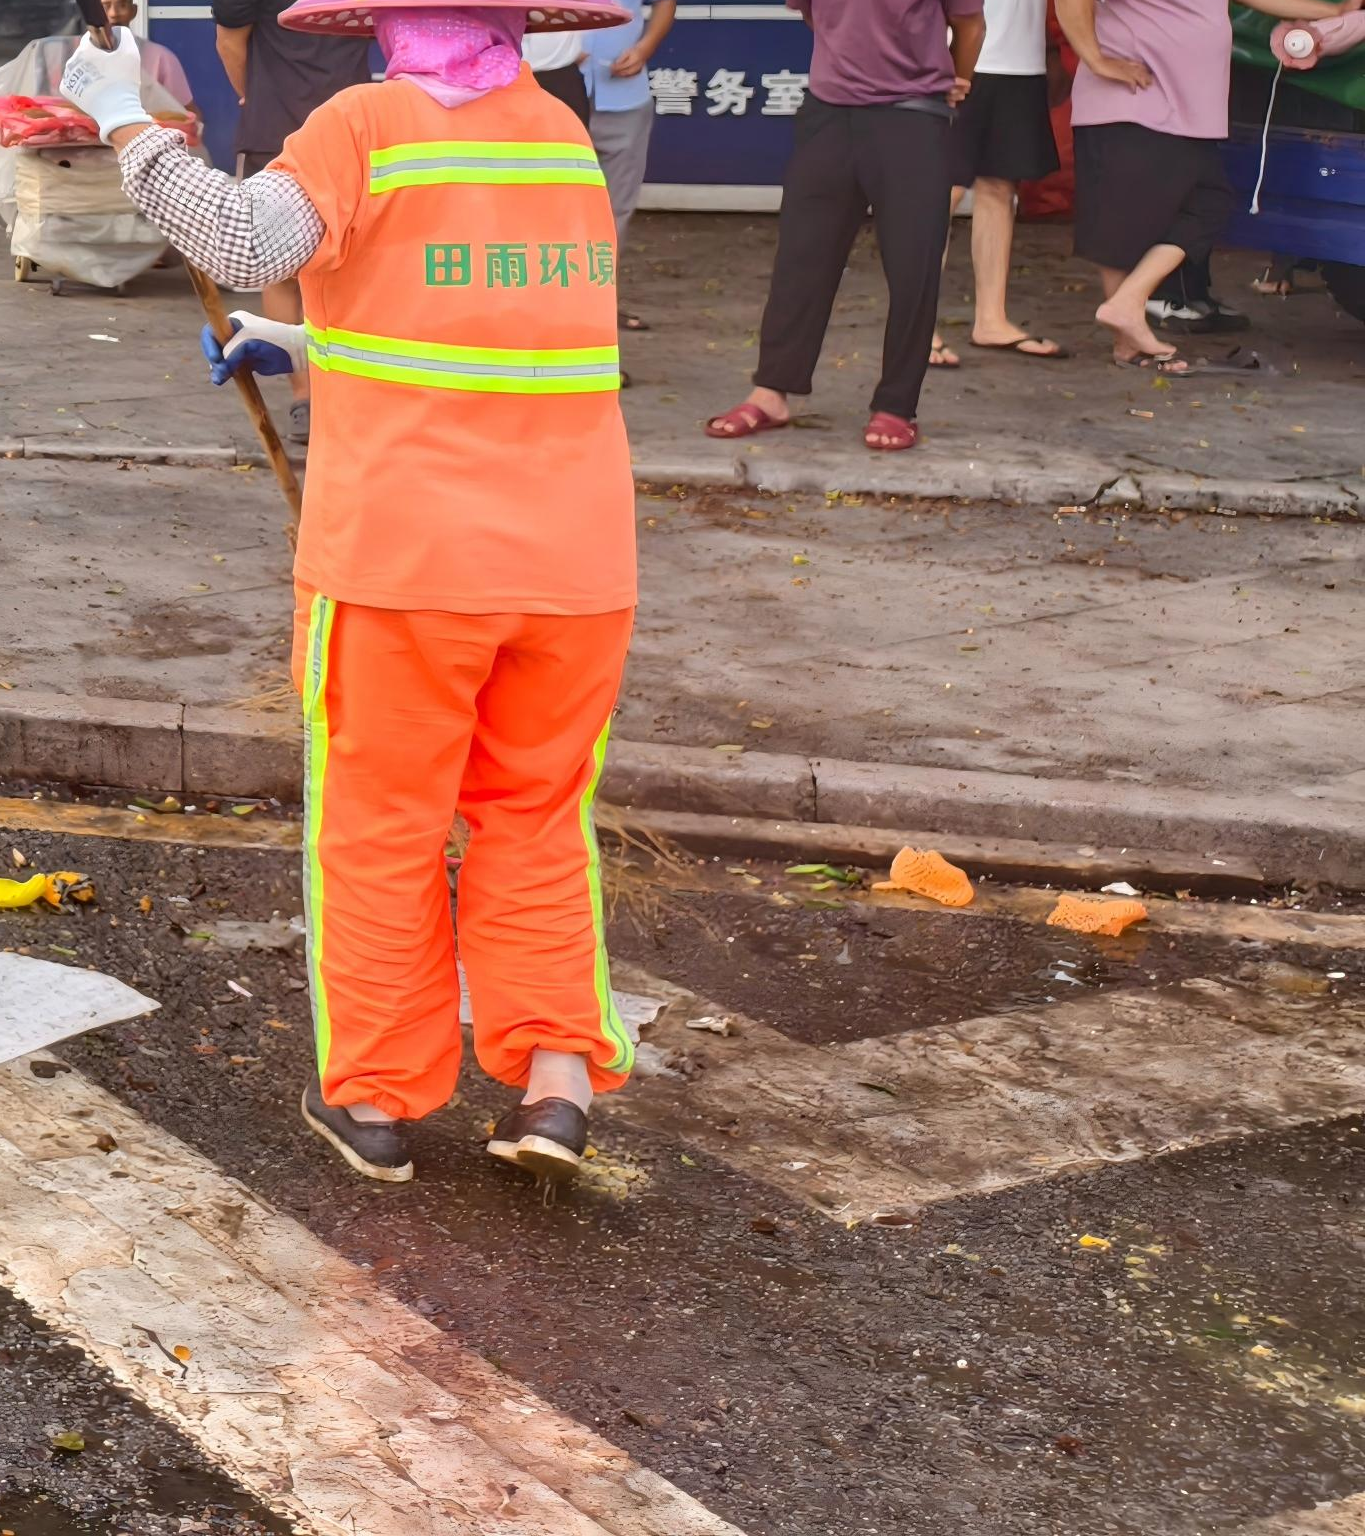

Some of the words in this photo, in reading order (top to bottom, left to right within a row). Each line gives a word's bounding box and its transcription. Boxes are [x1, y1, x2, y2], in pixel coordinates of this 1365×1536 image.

[648, 68, 810, 116] 警务室
[425, 240, 615, 288] 田雨环境
